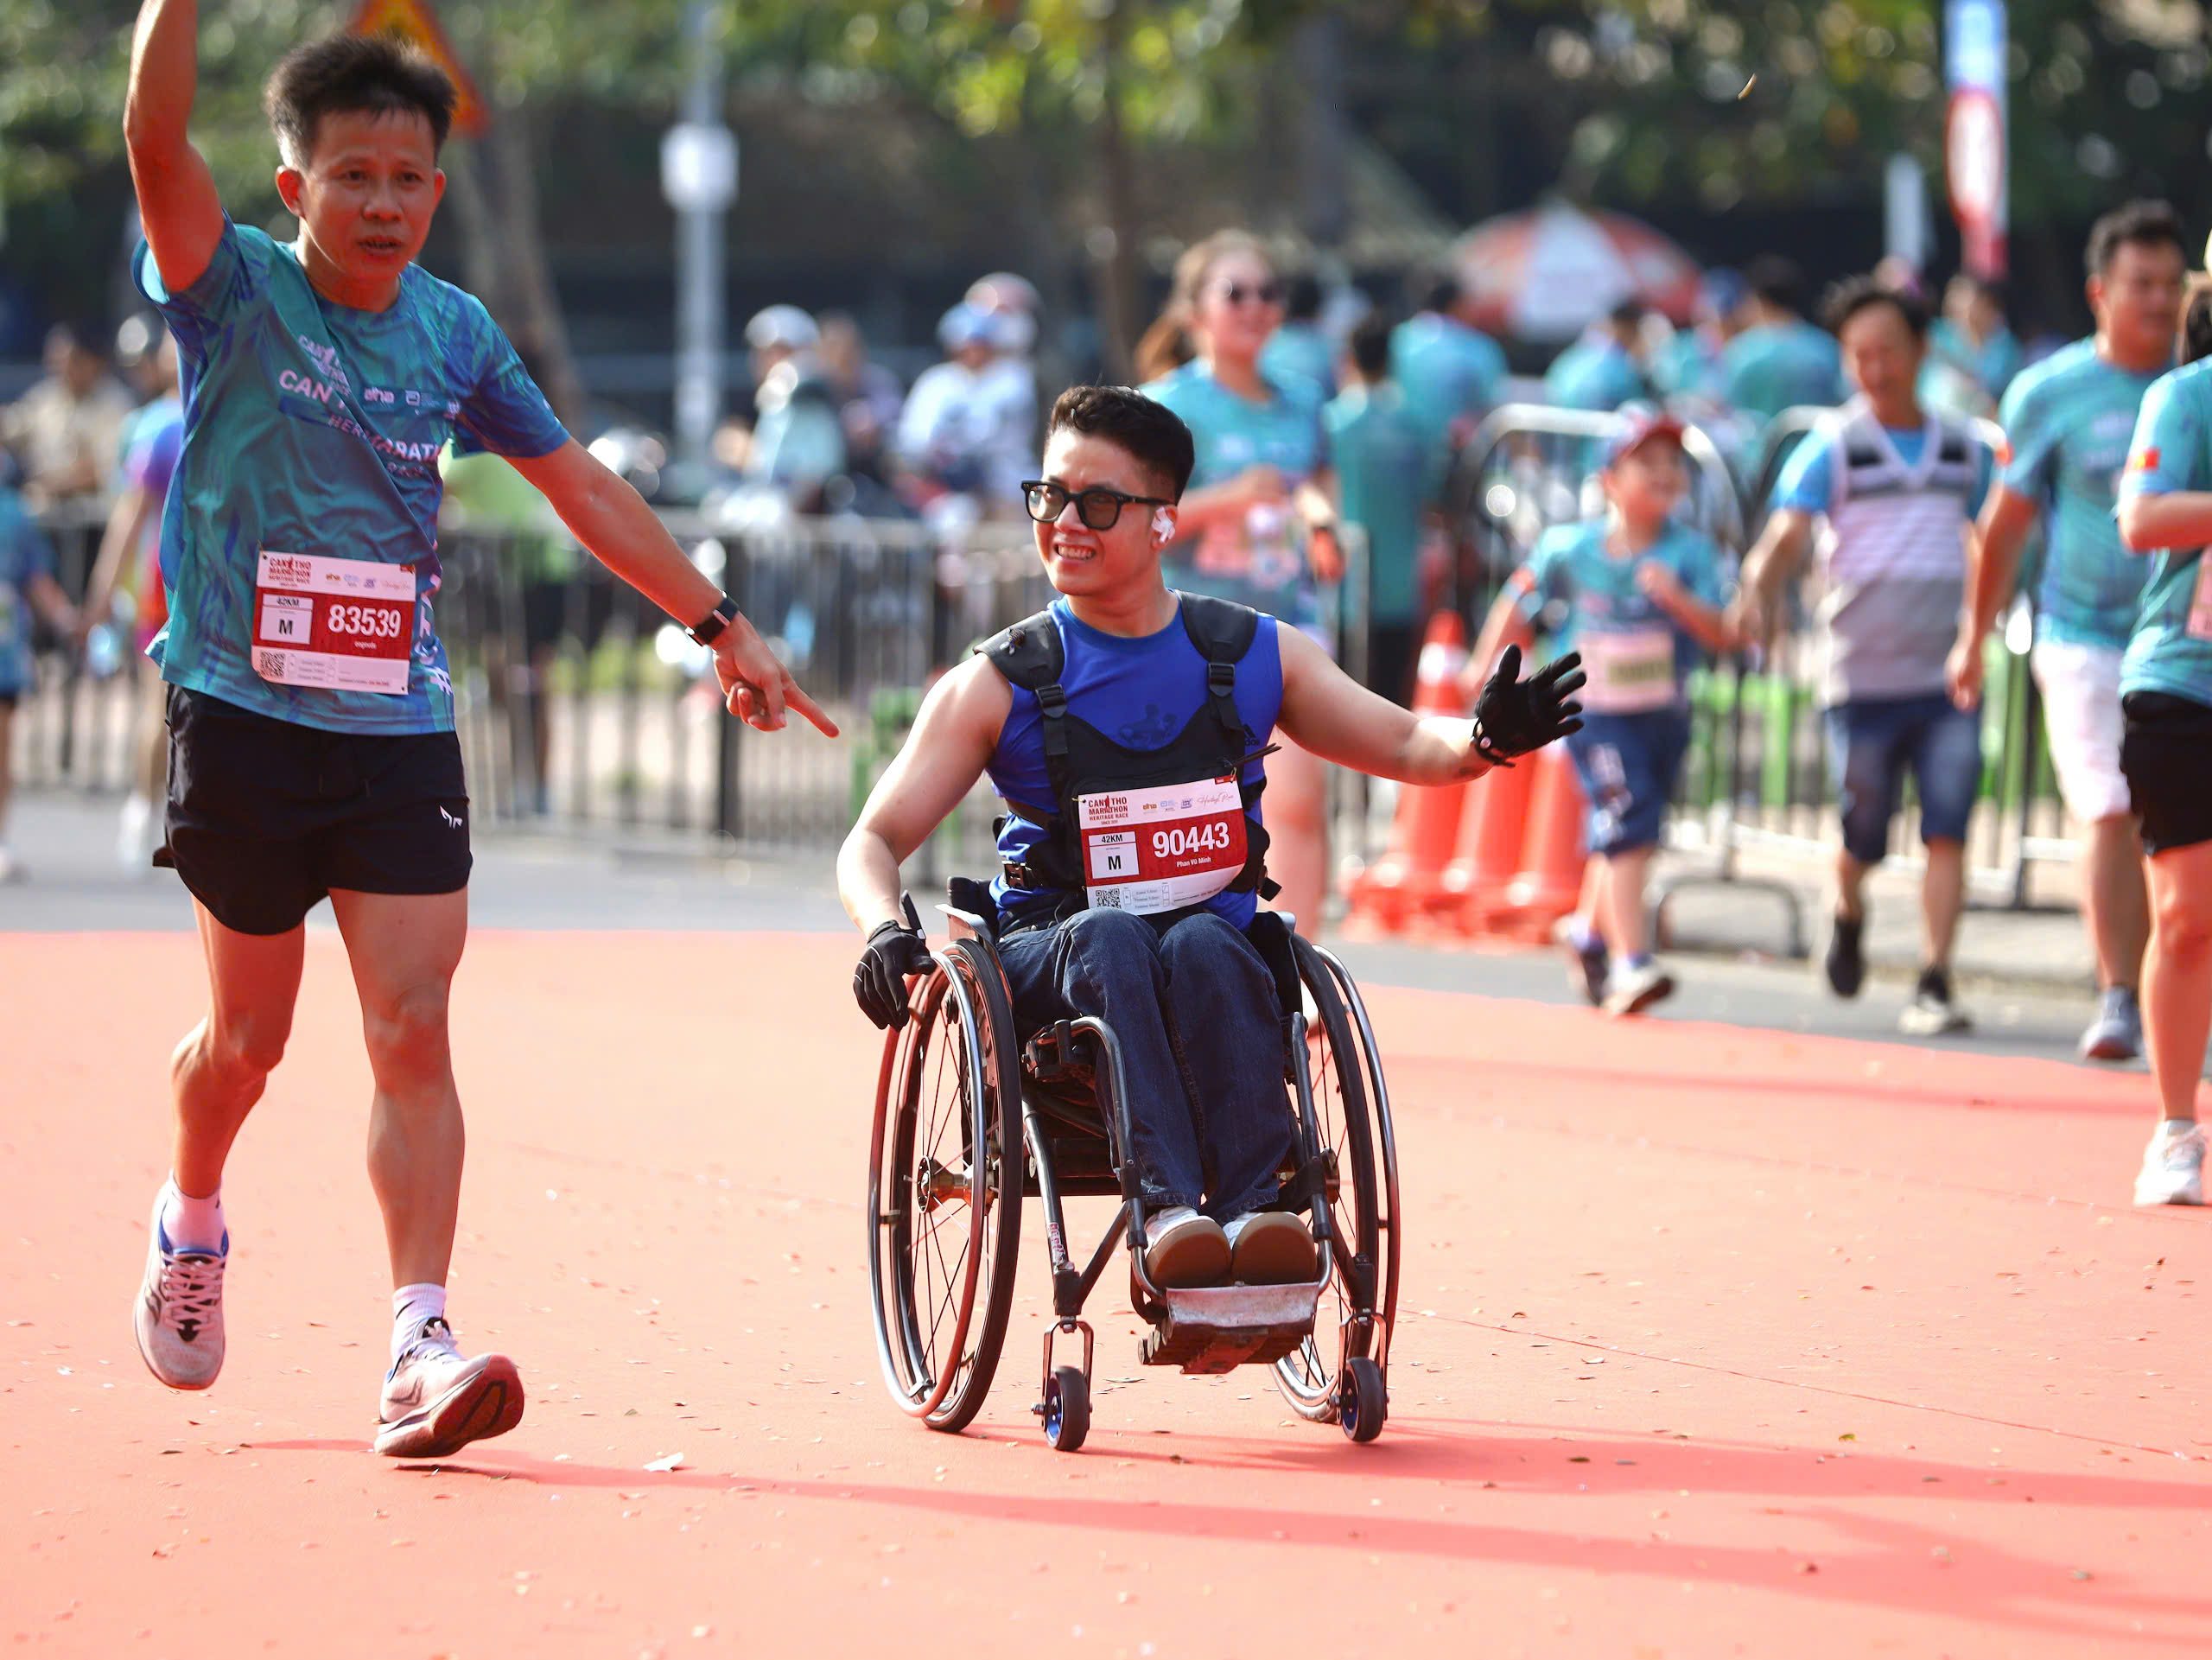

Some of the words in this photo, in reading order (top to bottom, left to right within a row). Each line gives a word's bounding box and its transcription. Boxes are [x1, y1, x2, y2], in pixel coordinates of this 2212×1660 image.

[278, 369, 333, 404] CAN
[276, 598, 301, 607] 42KM
[278, 619, 294, 636] M
[327, 603, 402, 639] 83539
[1089, 798, 1105, 808] CAN
[1111, 796, 1128, 805] THO
[1089, 805, 1128, 816] MARATHON
[1101, 834, 1123, 843] 42KM
[1152, 822, 1230, 858] 90443
[1108, 855, 1122, 871] M
